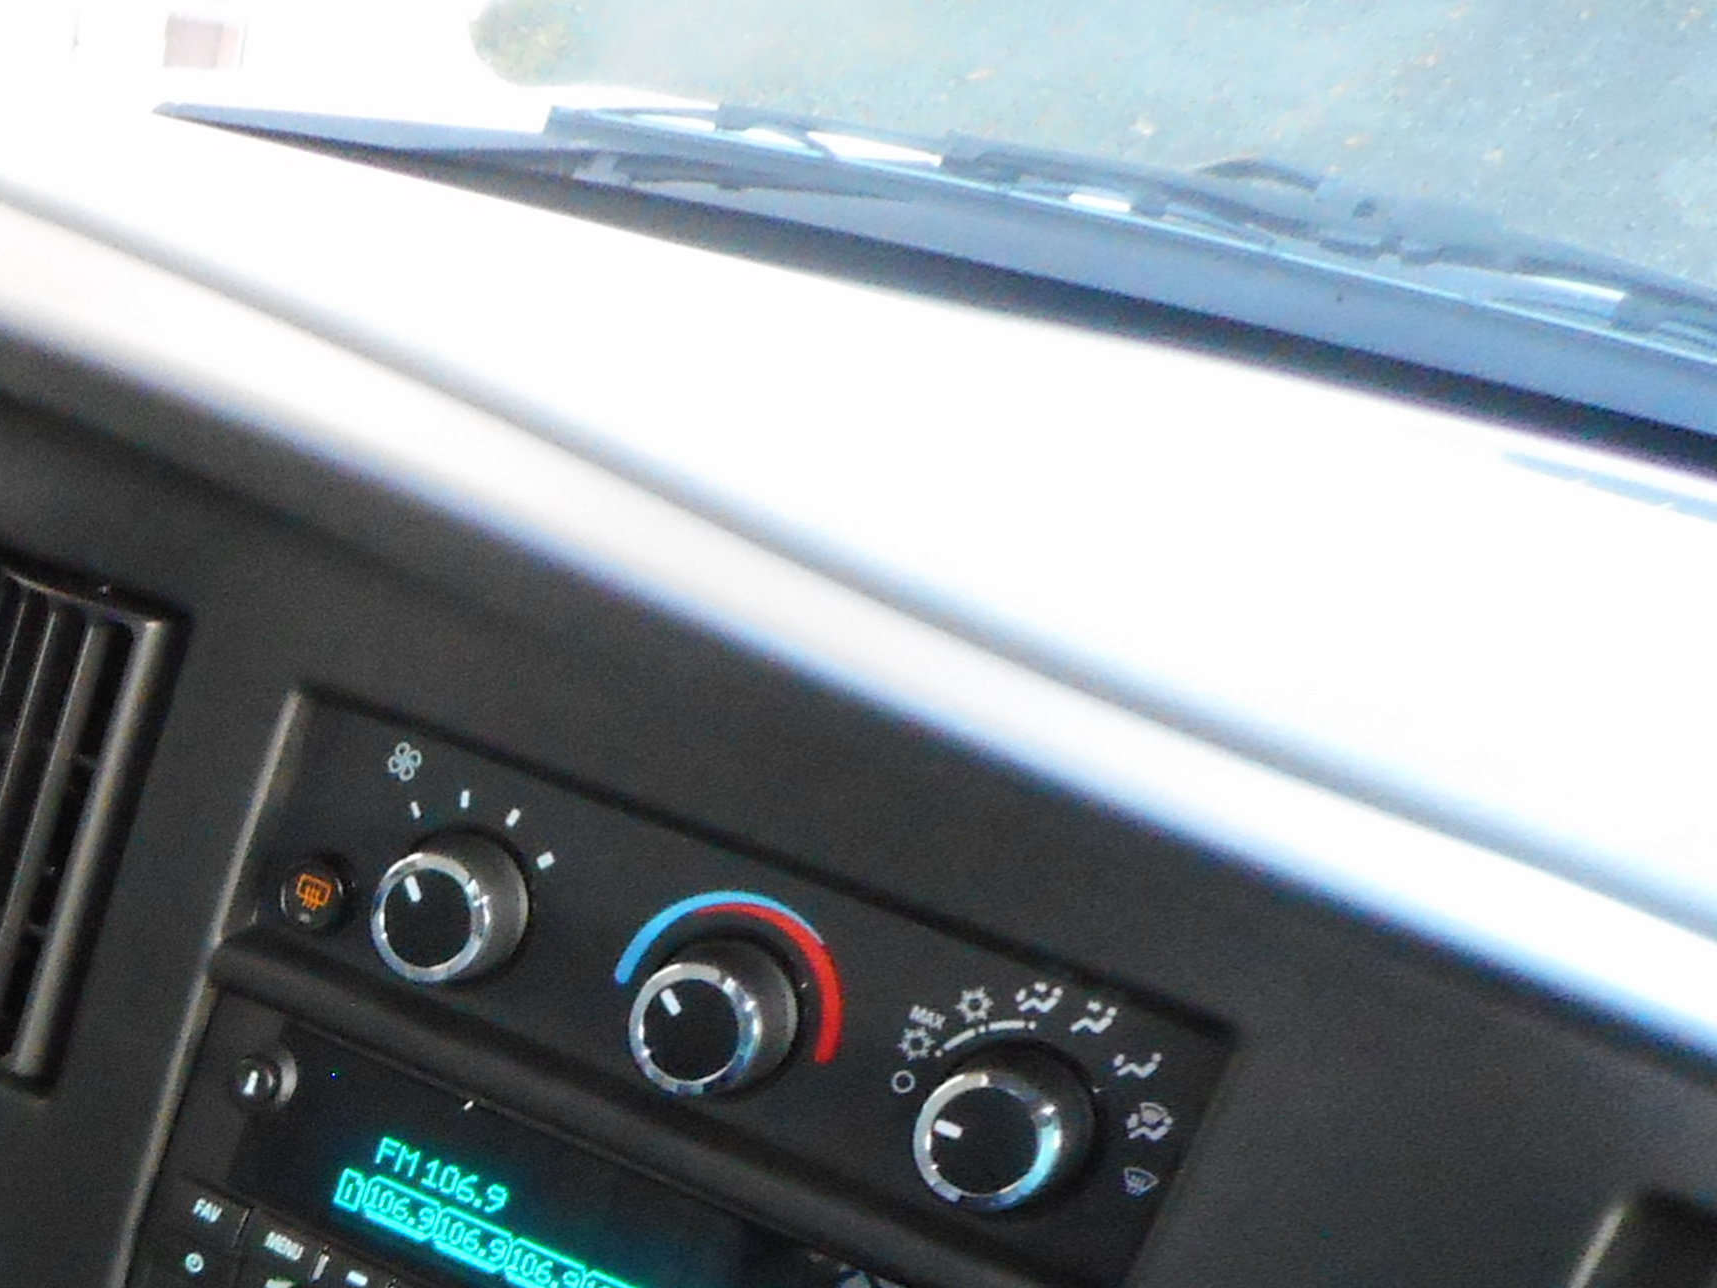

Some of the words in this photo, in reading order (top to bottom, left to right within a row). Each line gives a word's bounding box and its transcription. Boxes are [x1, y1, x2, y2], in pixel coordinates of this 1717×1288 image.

[909, 1005, 946, 1030] MAX
[375, 1136, 421, 1178] FM
[421, 1160, 509, 1214] 106.9
[192, 1197, 223, 1224] FAV
[365, 1185, 436, 1232] 106.9
[434, 1216, 509, 1263] 106.9
[263, 1230, 305, 1262] MENU
